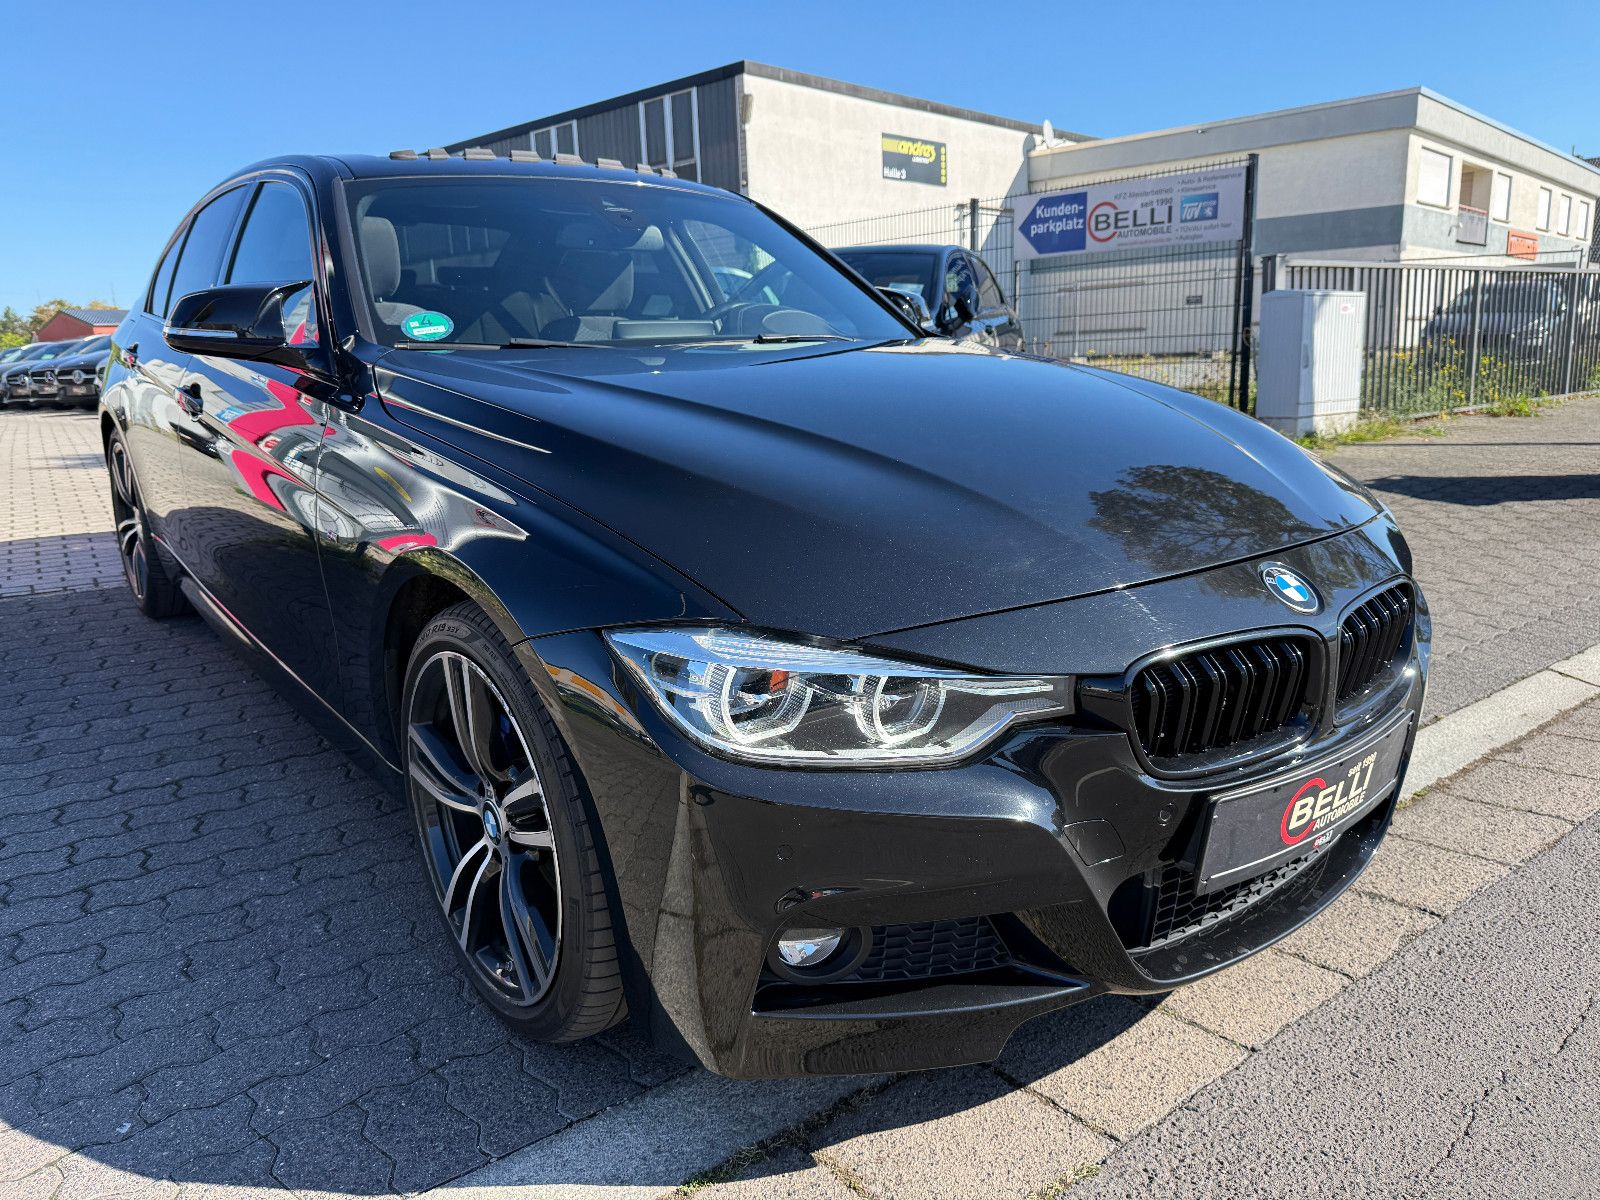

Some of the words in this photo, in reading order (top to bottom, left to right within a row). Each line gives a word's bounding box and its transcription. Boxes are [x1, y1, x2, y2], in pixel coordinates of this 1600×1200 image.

[1036, 202, 1084, 219] Kunden-
[1094, 205, 1173, 232] BELLI
[1030, 217, 1084, 237] parkplatz
[1117, 225, 1172, 239] AUTOMOBILE
[421, 315, 432, 326] 4
[1288, 762, 1374, 830] BELLI
[1313, 791, 1365, 831] AUTOMOBILE
